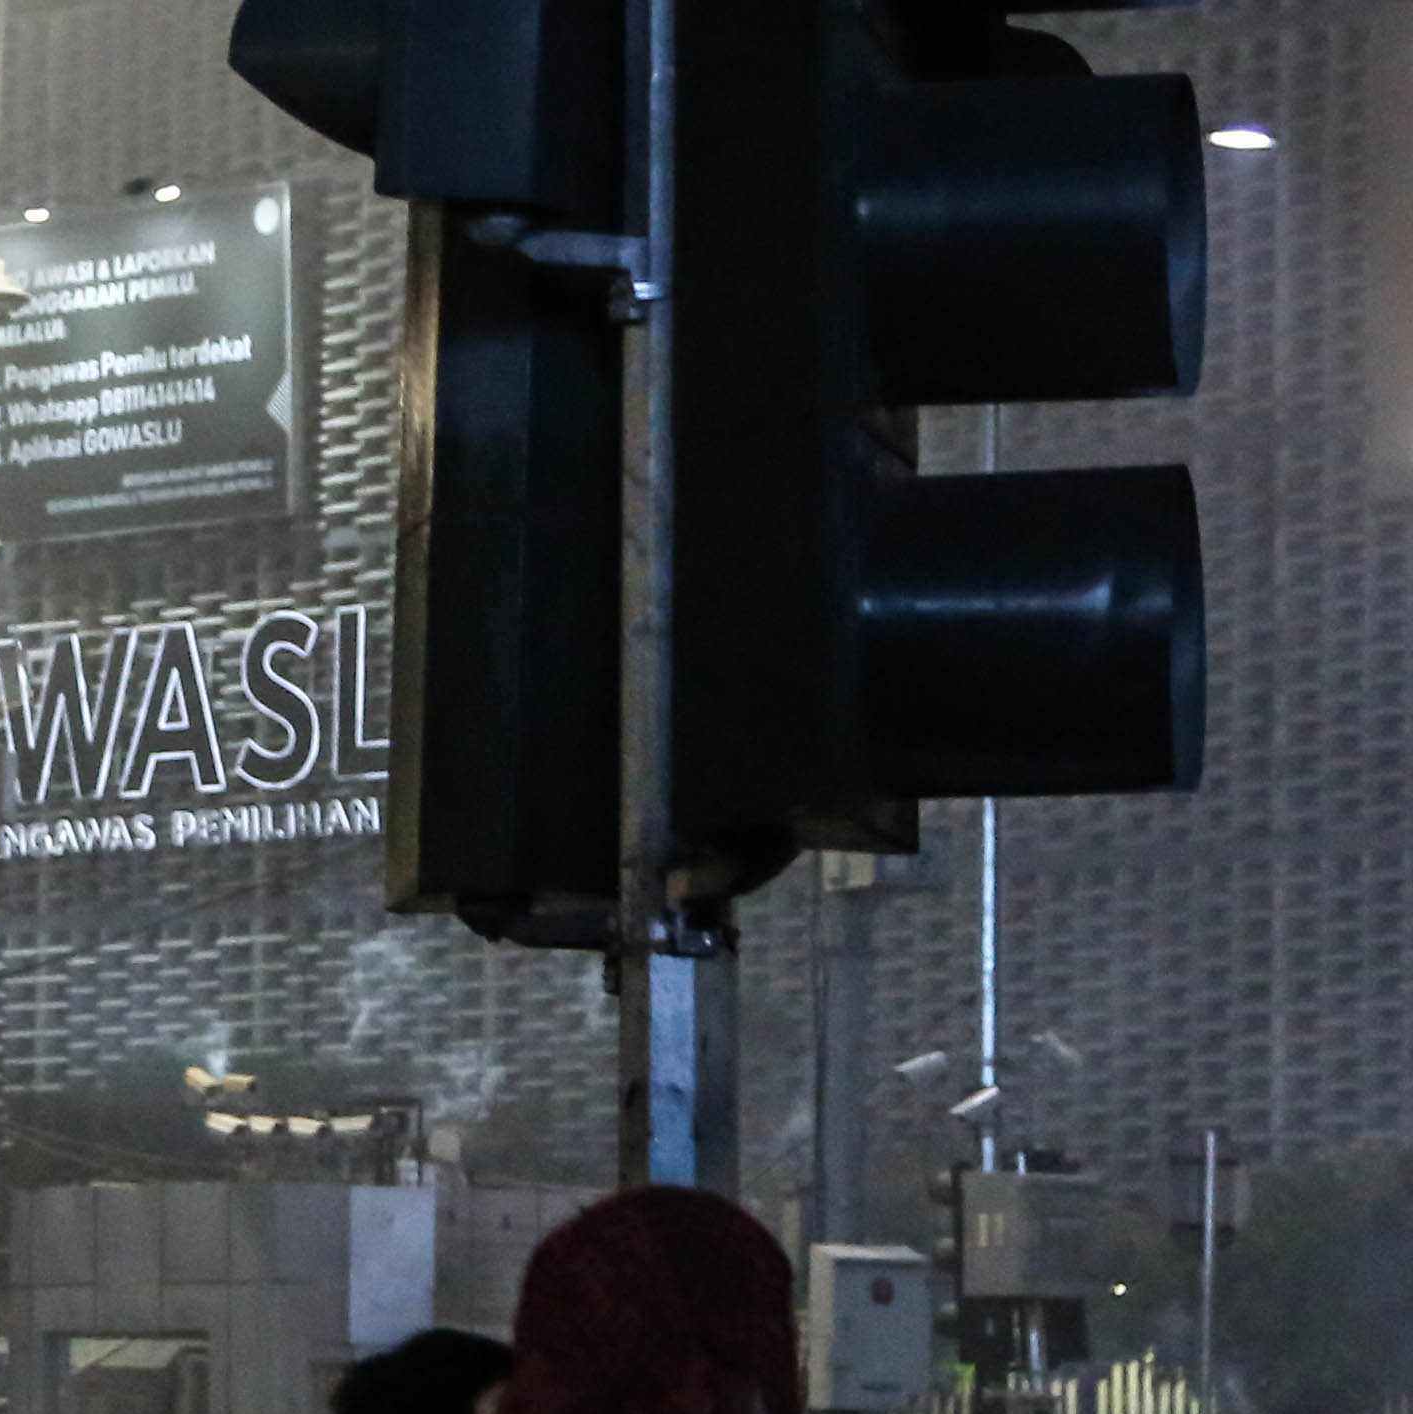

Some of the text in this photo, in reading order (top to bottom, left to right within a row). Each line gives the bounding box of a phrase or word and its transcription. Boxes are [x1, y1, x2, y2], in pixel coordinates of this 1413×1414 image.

[113, 241, 216, 278] LAPORKAN
[5, 358, 99, 393] Pengawas
[100, 345, 168, 376] Pemilu
[170, 334, 252, 367] terdekat
[84, 418, 183, 455] GOWASLU
[171, 797, 382, 848] PEMILIHAN
